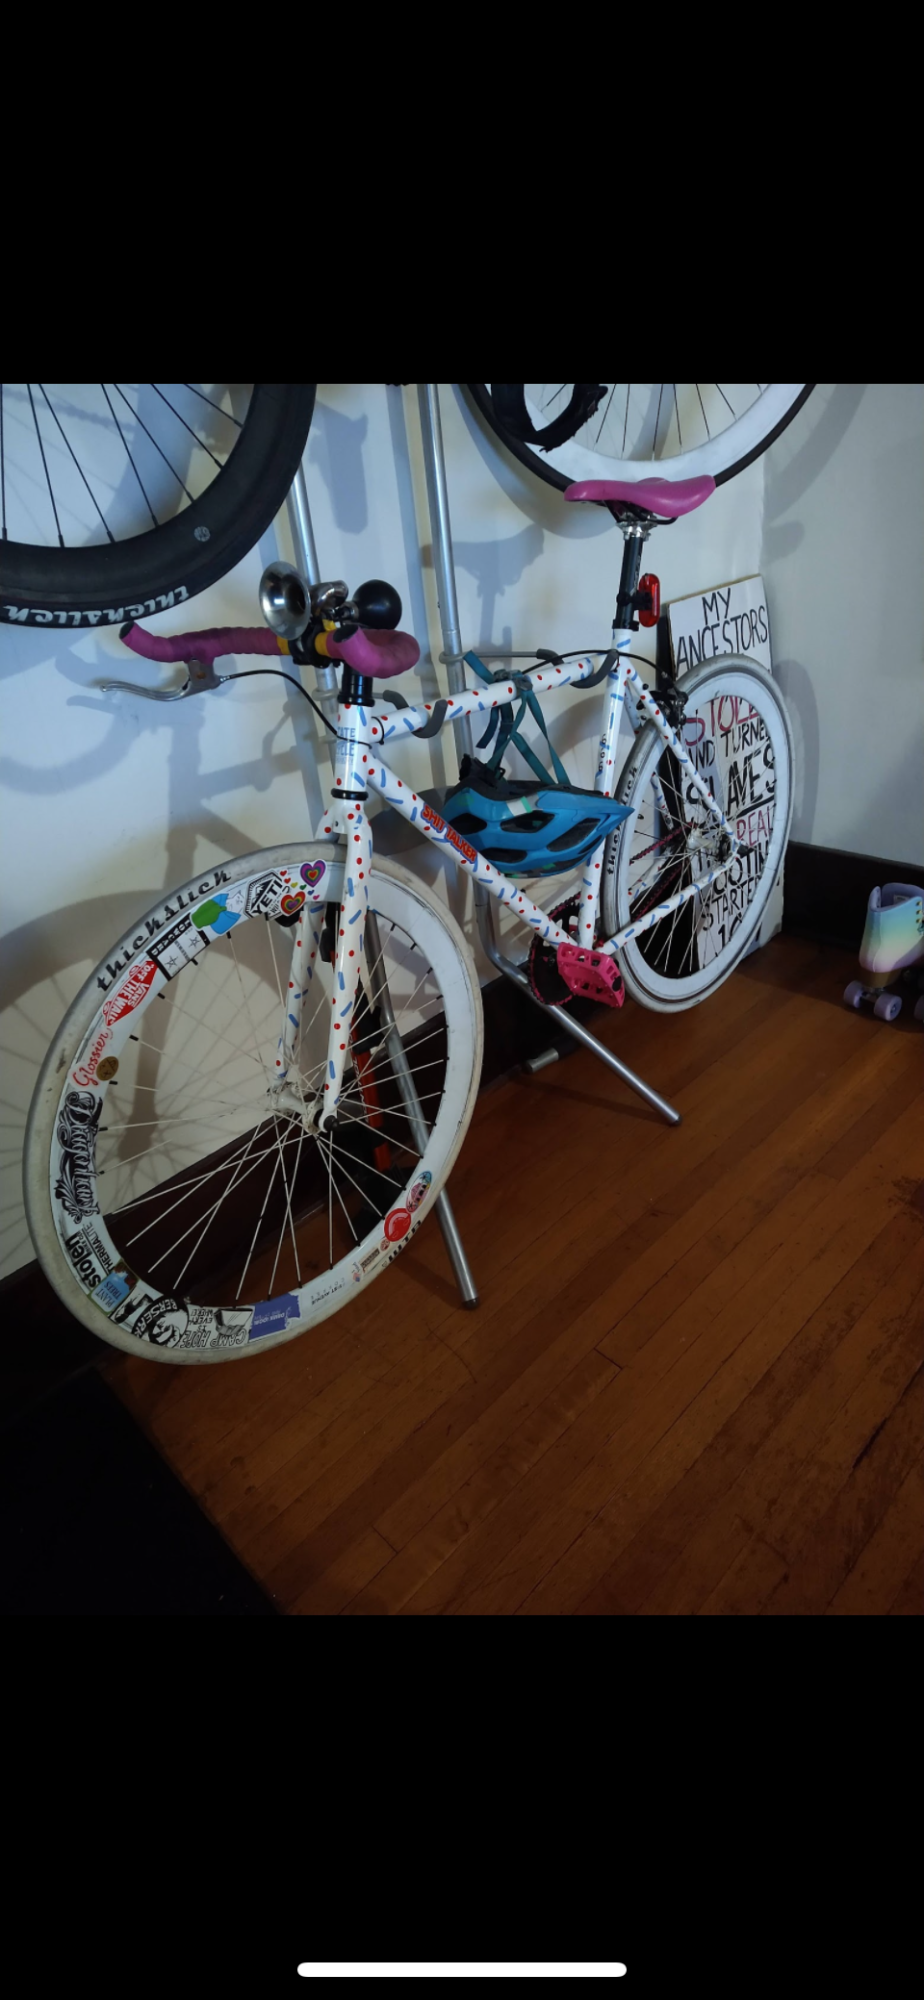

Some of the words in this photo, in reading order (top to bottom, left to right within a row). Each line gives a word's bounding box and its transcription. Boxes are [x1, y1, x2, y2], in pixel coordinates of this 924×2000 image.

[702, 588, 731, 625] MY
[676, 605, 768, 677] ANCESTORS
[684, 696, 759, 745] STOLE
[721, 718, 771, 757] TURNE
[421, 804, 446, 832] SHIT
[446, 824, 478, 863] TALKER
[252, 880, 283, 914] YETI
[702, 875, 762, 930] STARTE
[97, 869, 232, 992] thickslick
[120, 979, 140, 1000] THE
[128, 982, 150, 1008] VANS
[71, 1031, 110, 1087] Glossier
[65, 1232, 102, 1288] stolen
[95, 1288, 115, 1308] PLANT
[103, 1281, 122, 1300] TREES
[210, 1328, 247, 1348] CAMP
